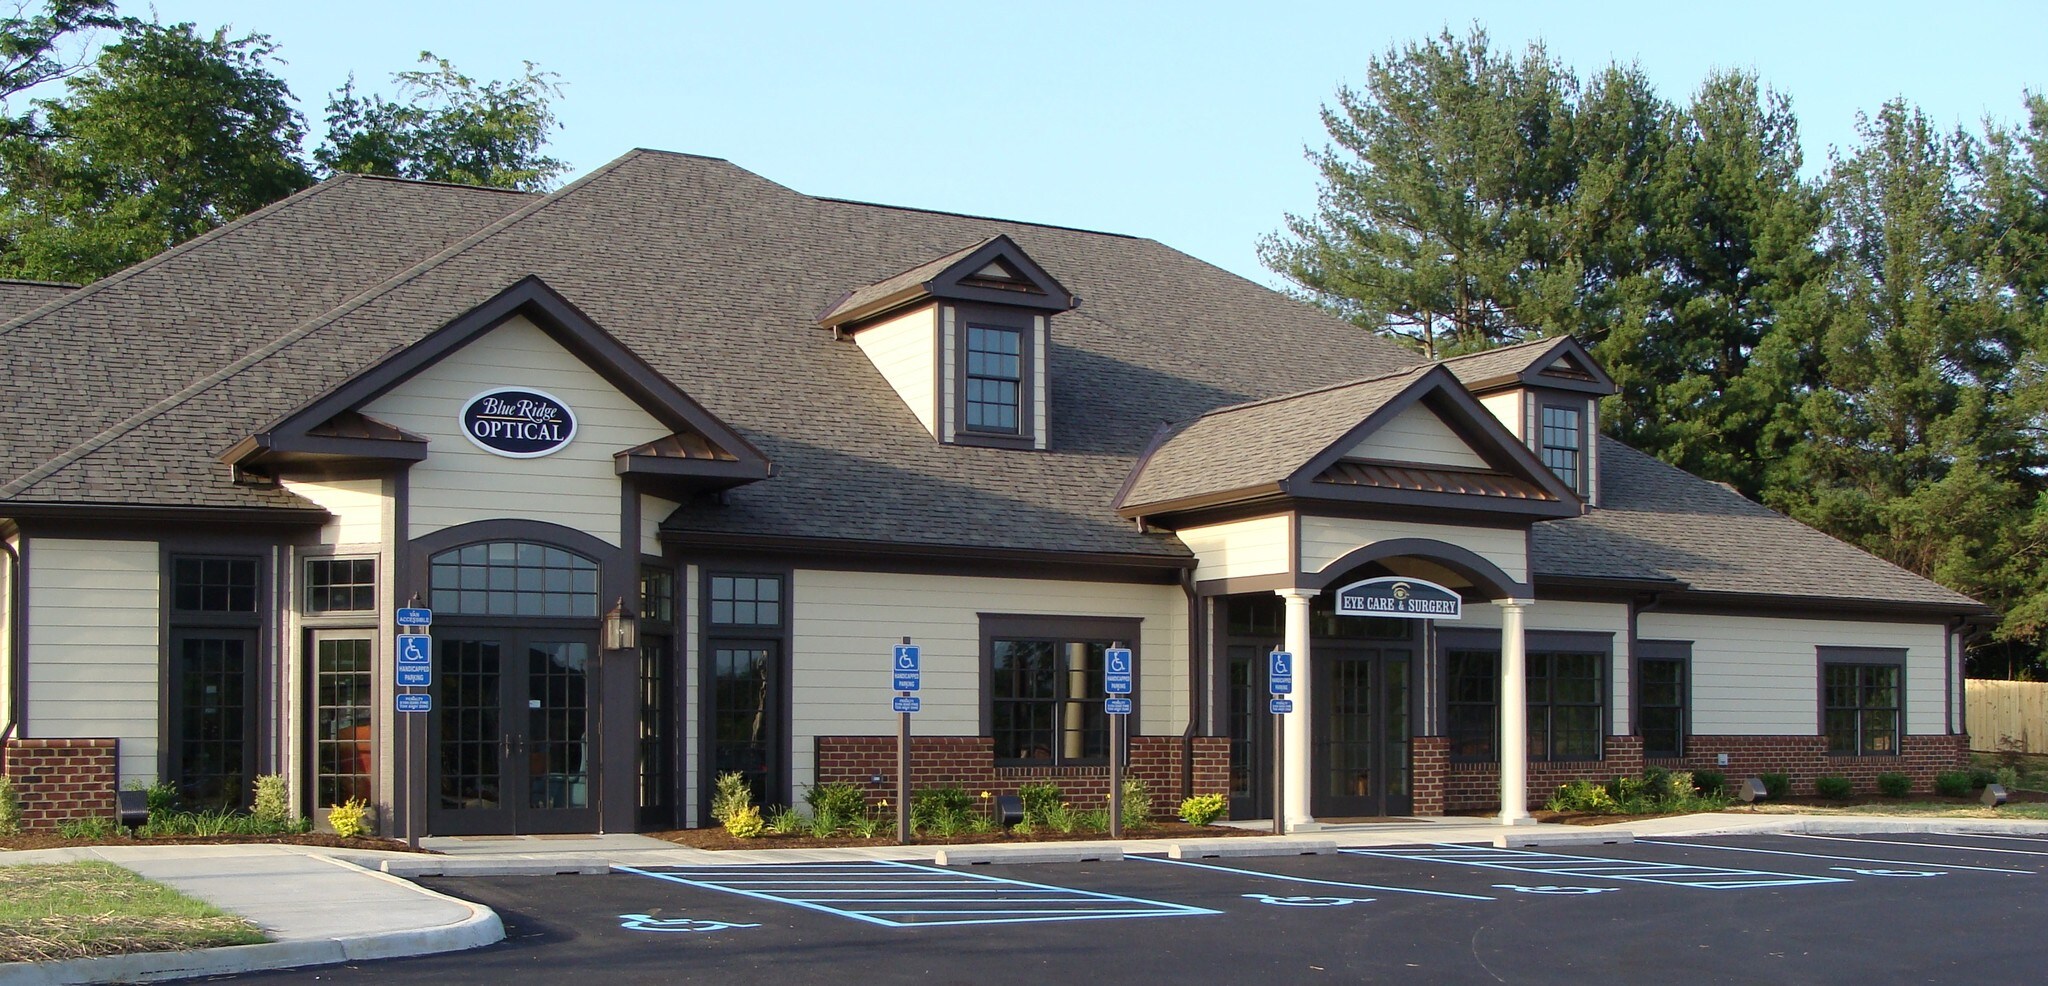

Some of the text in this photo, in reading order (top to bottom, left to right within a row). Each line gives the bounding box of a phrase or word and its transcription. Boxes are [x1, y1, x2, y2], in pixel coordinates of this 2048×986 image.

[483, 397, 557, 424] Blue Ridge
[474, 420, 565, 441] OPTICAL
[1343, 596, 1456, 613] EYE CARE & SURGERY
